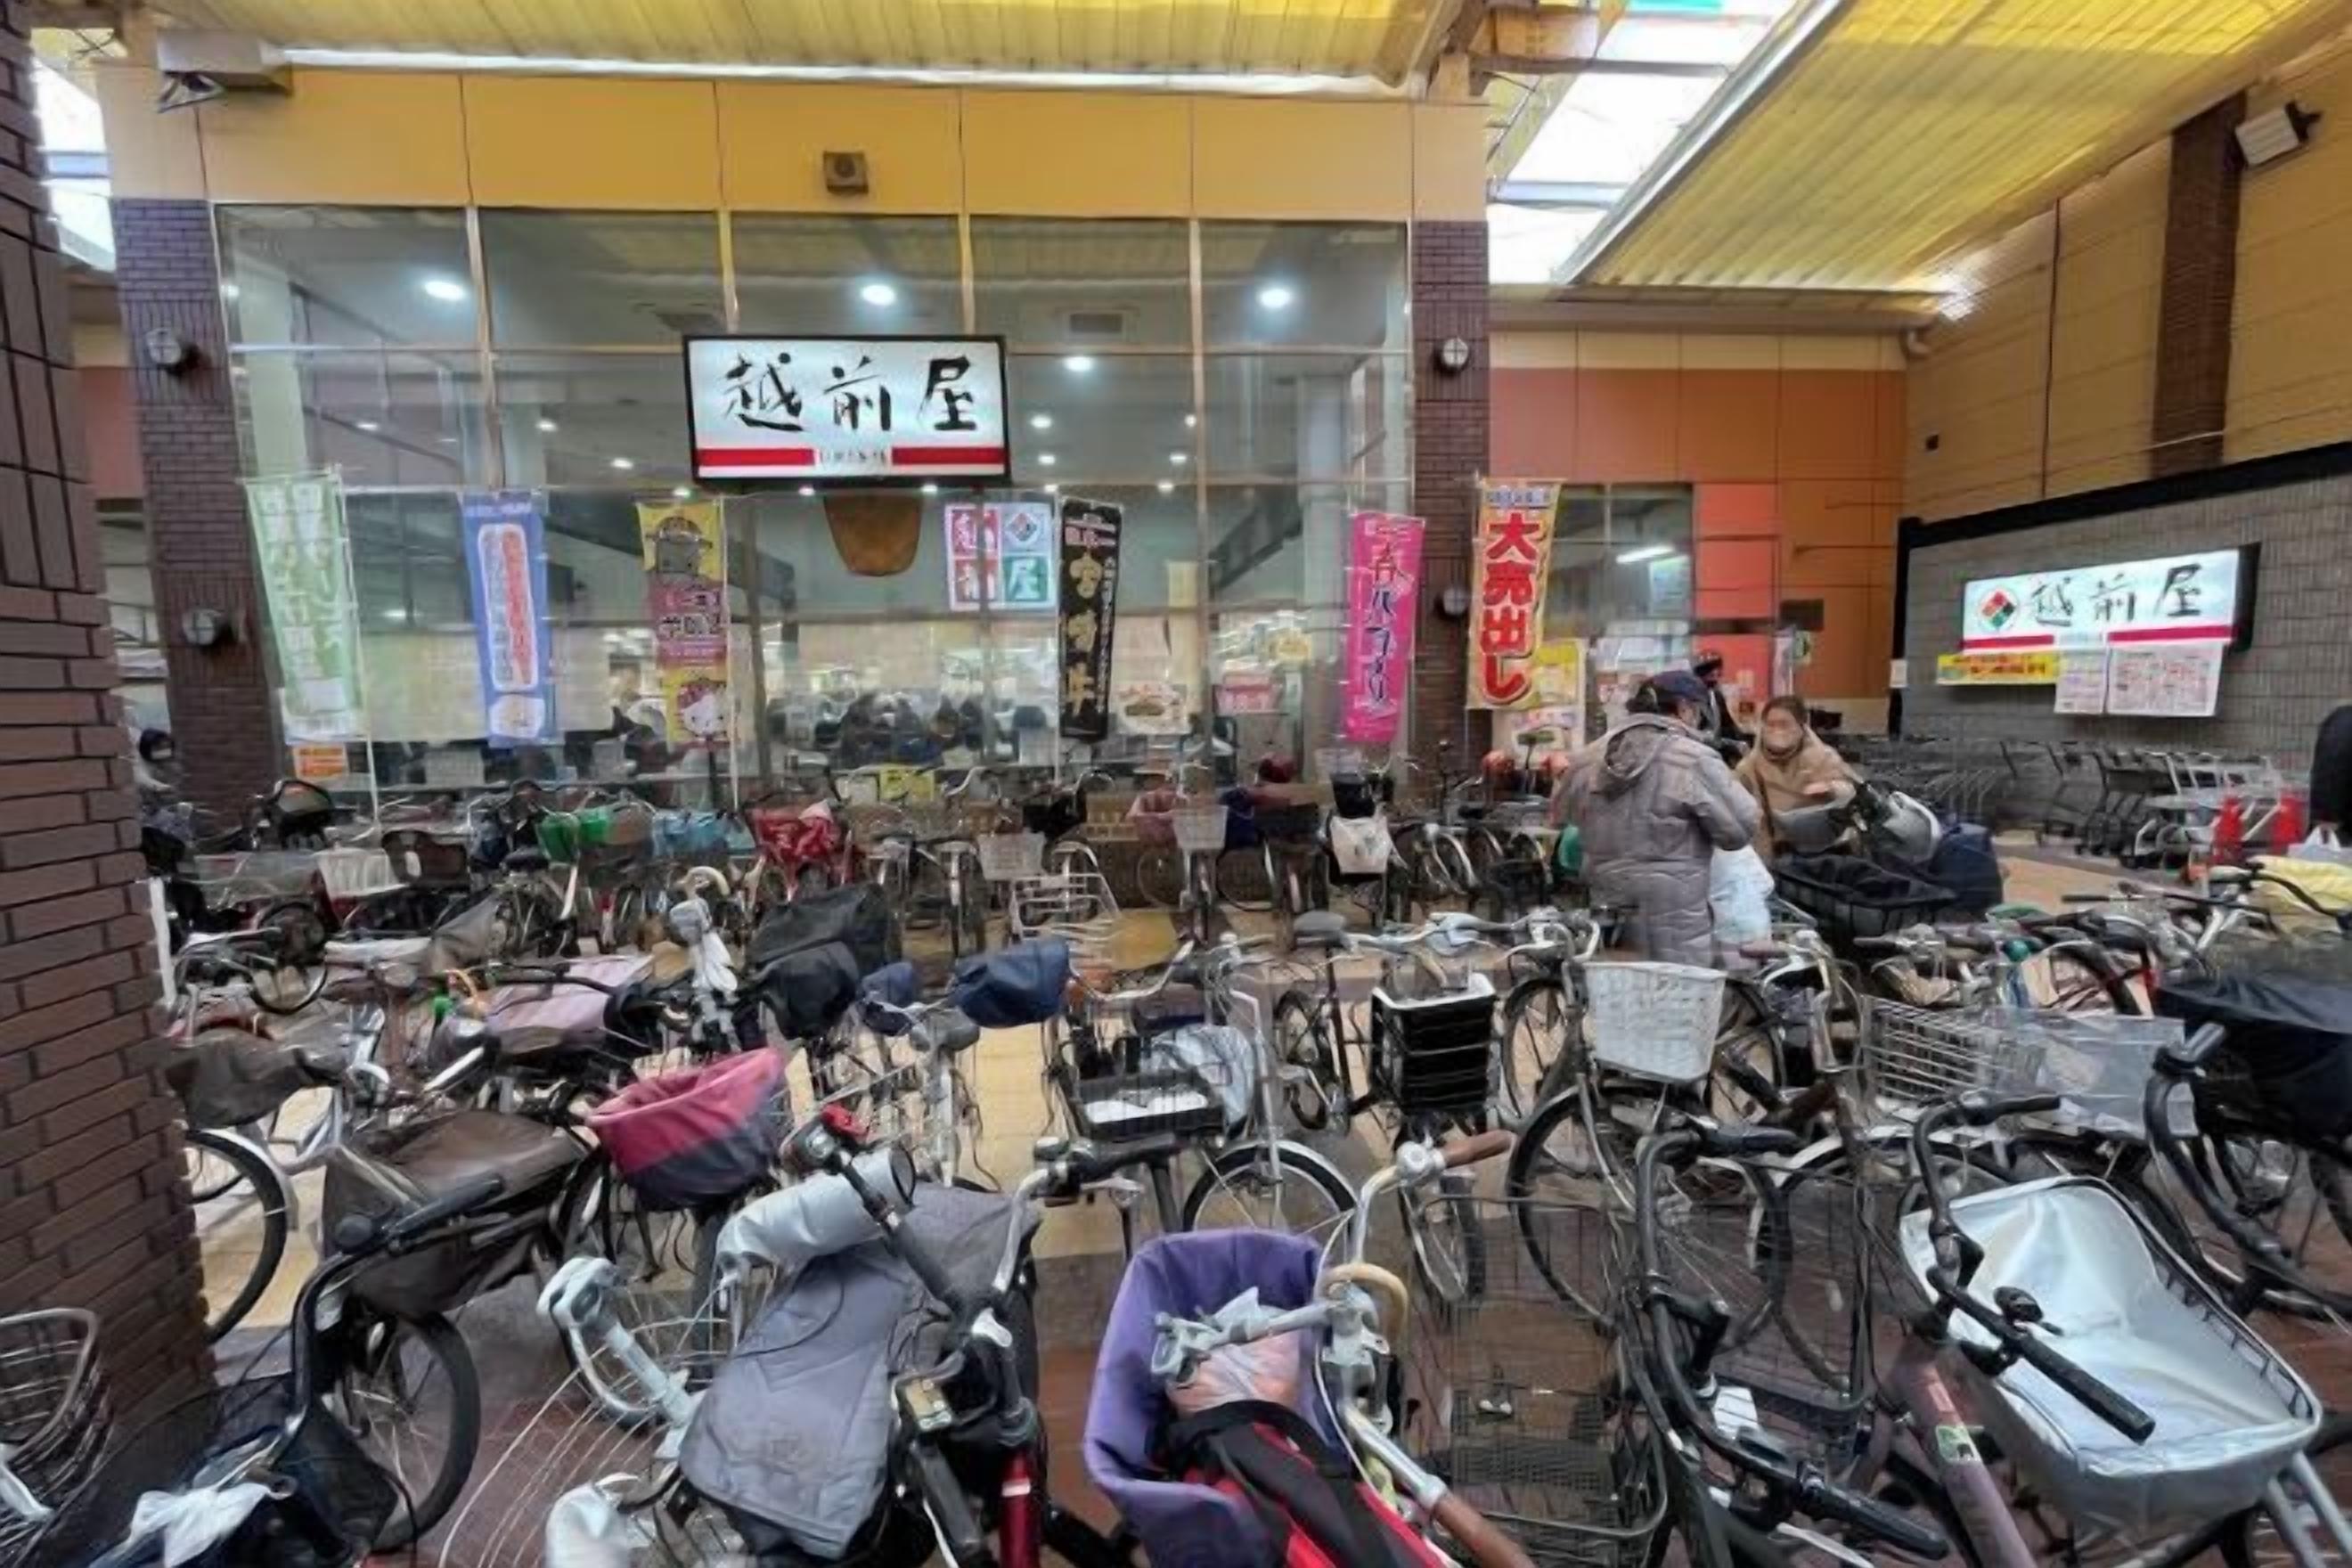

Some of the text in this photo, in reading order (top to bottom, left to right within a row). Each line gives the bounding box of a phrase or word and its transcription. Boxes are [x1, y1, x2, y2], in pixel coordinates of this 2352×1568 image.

[723, 352, 977, 432] 越前屋
[1481, 512, 1540, 698] 大売出し
[2031, 564, 2202, 627] 越前屋
